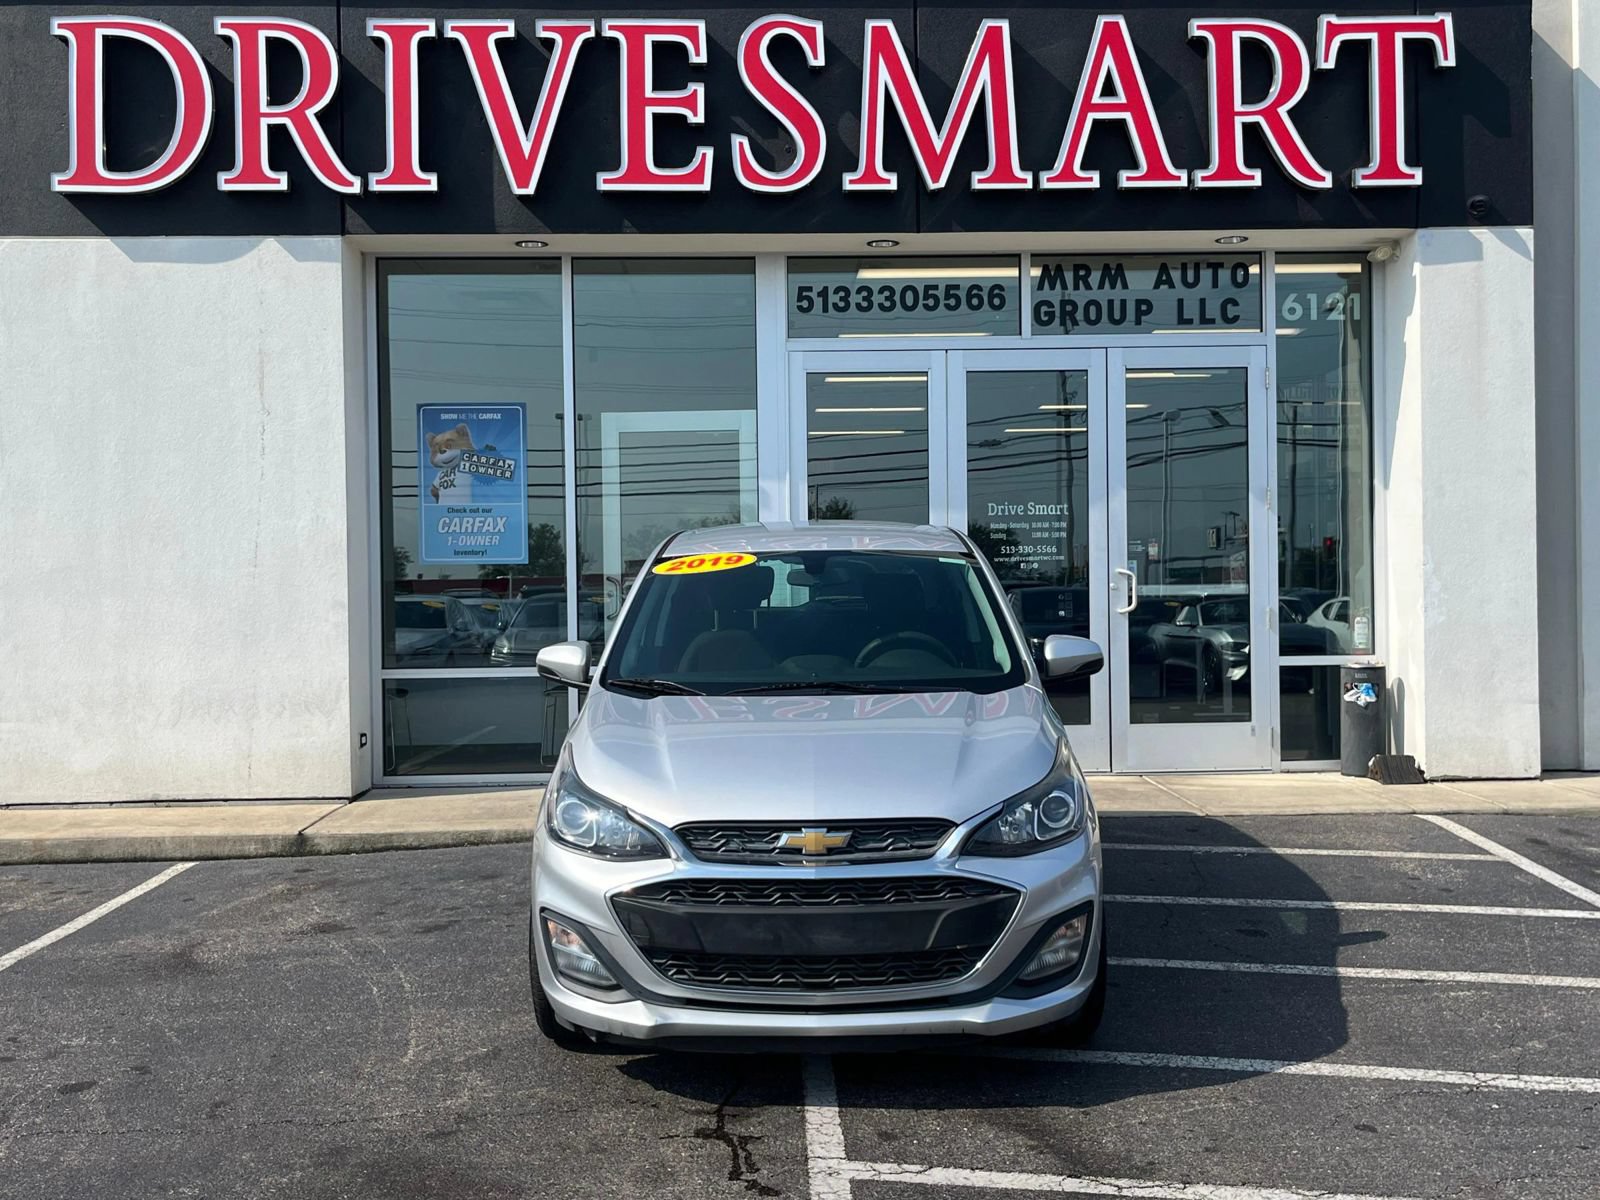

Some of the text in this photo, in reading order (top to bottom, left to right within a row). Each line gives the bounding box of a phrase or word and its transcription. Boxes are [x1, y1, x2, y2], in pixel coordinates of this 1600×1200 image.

[50, 12, 1456, 197] DRIVESMART
[1036, 262, 1250, 291] MRM AUTO
[796, 284, 1006, 313] 5133305566
[1281, 292, 1361, 321] 6121
[1033, 297, 1241, 327] GROUP LLC
[463, 453, 513, 470] CARFAX
[470, 465, 512, 479] OWNER
[439, 478, 456, 490] FOX
[987, 501, 1069, 516] Drive Smart
[438, 516, 508, 533] CARFAX
[453, 549, 488, 557] Inventory!
[1001, 545, 1057, 554] 513-330-5566
[665, 555, 744, 573] 2019
